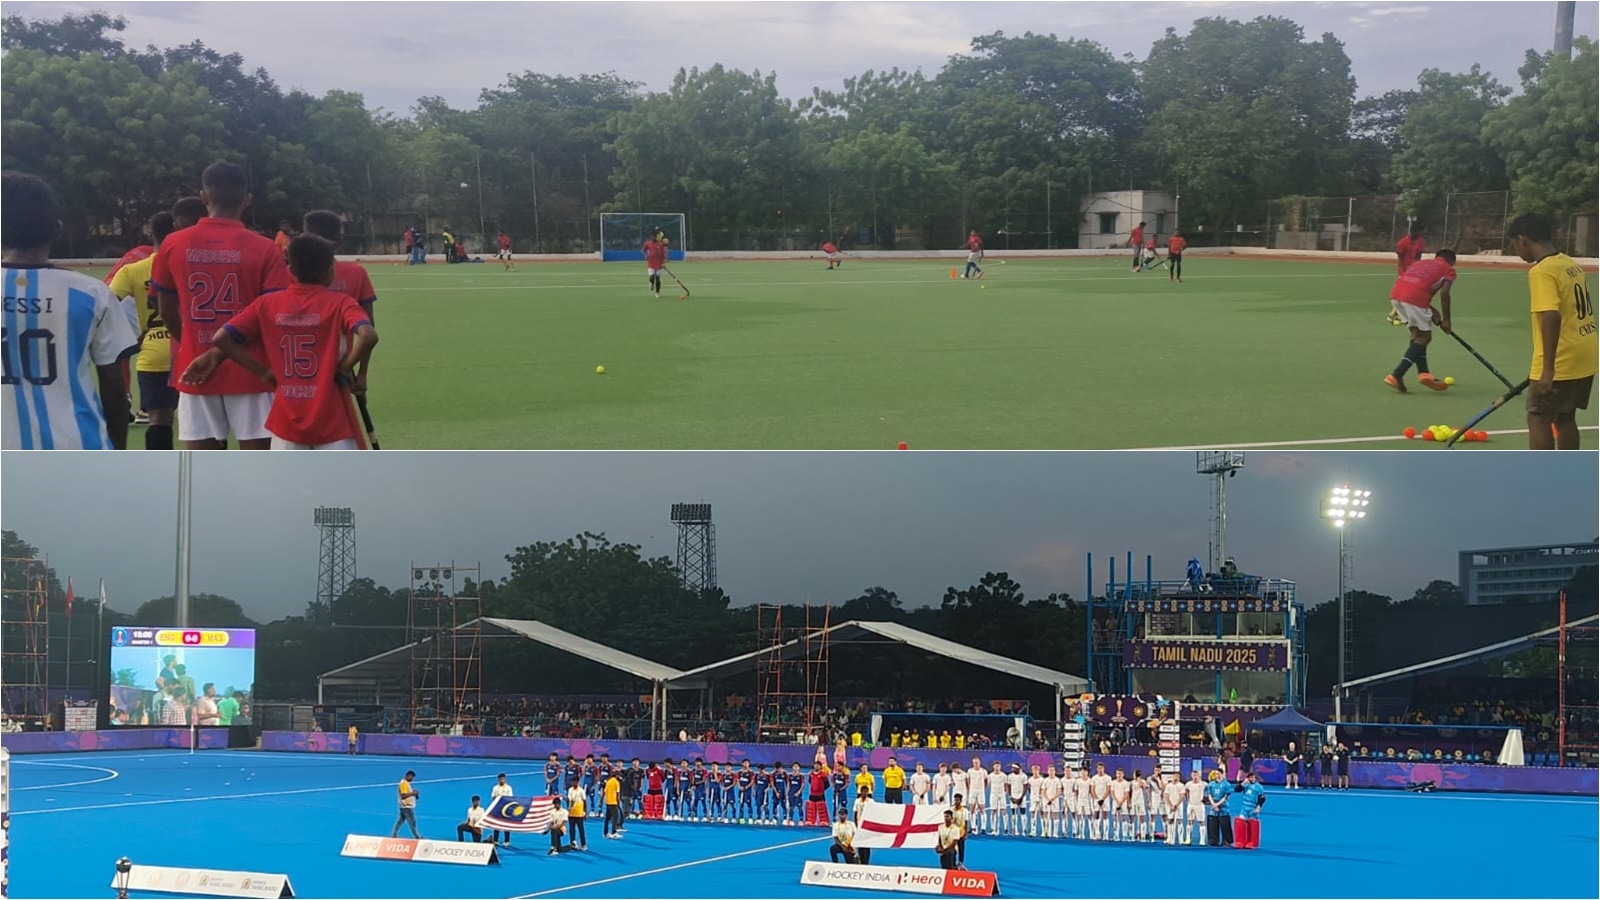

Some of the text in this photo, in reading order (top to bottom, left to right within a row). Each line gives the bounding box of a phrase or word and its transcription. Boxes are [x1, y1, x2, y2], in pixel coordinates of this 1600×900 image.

[1, 296, 53, 313] ESSI
[188, 271, 243, 320] 24
[281, 334, 319, 377] 15
[159, 633, 175, 641] ENG
[1151, 646, 1256, 664] TAMIL NADU 2025
[385, 843, 410, 853] VIDA
[433, 847, 463, 857] HOCKEY
[463, 849, 485, 858] INDIA
[826, 868, 986, 889] HOCKEY INDIA Hero VIDA
